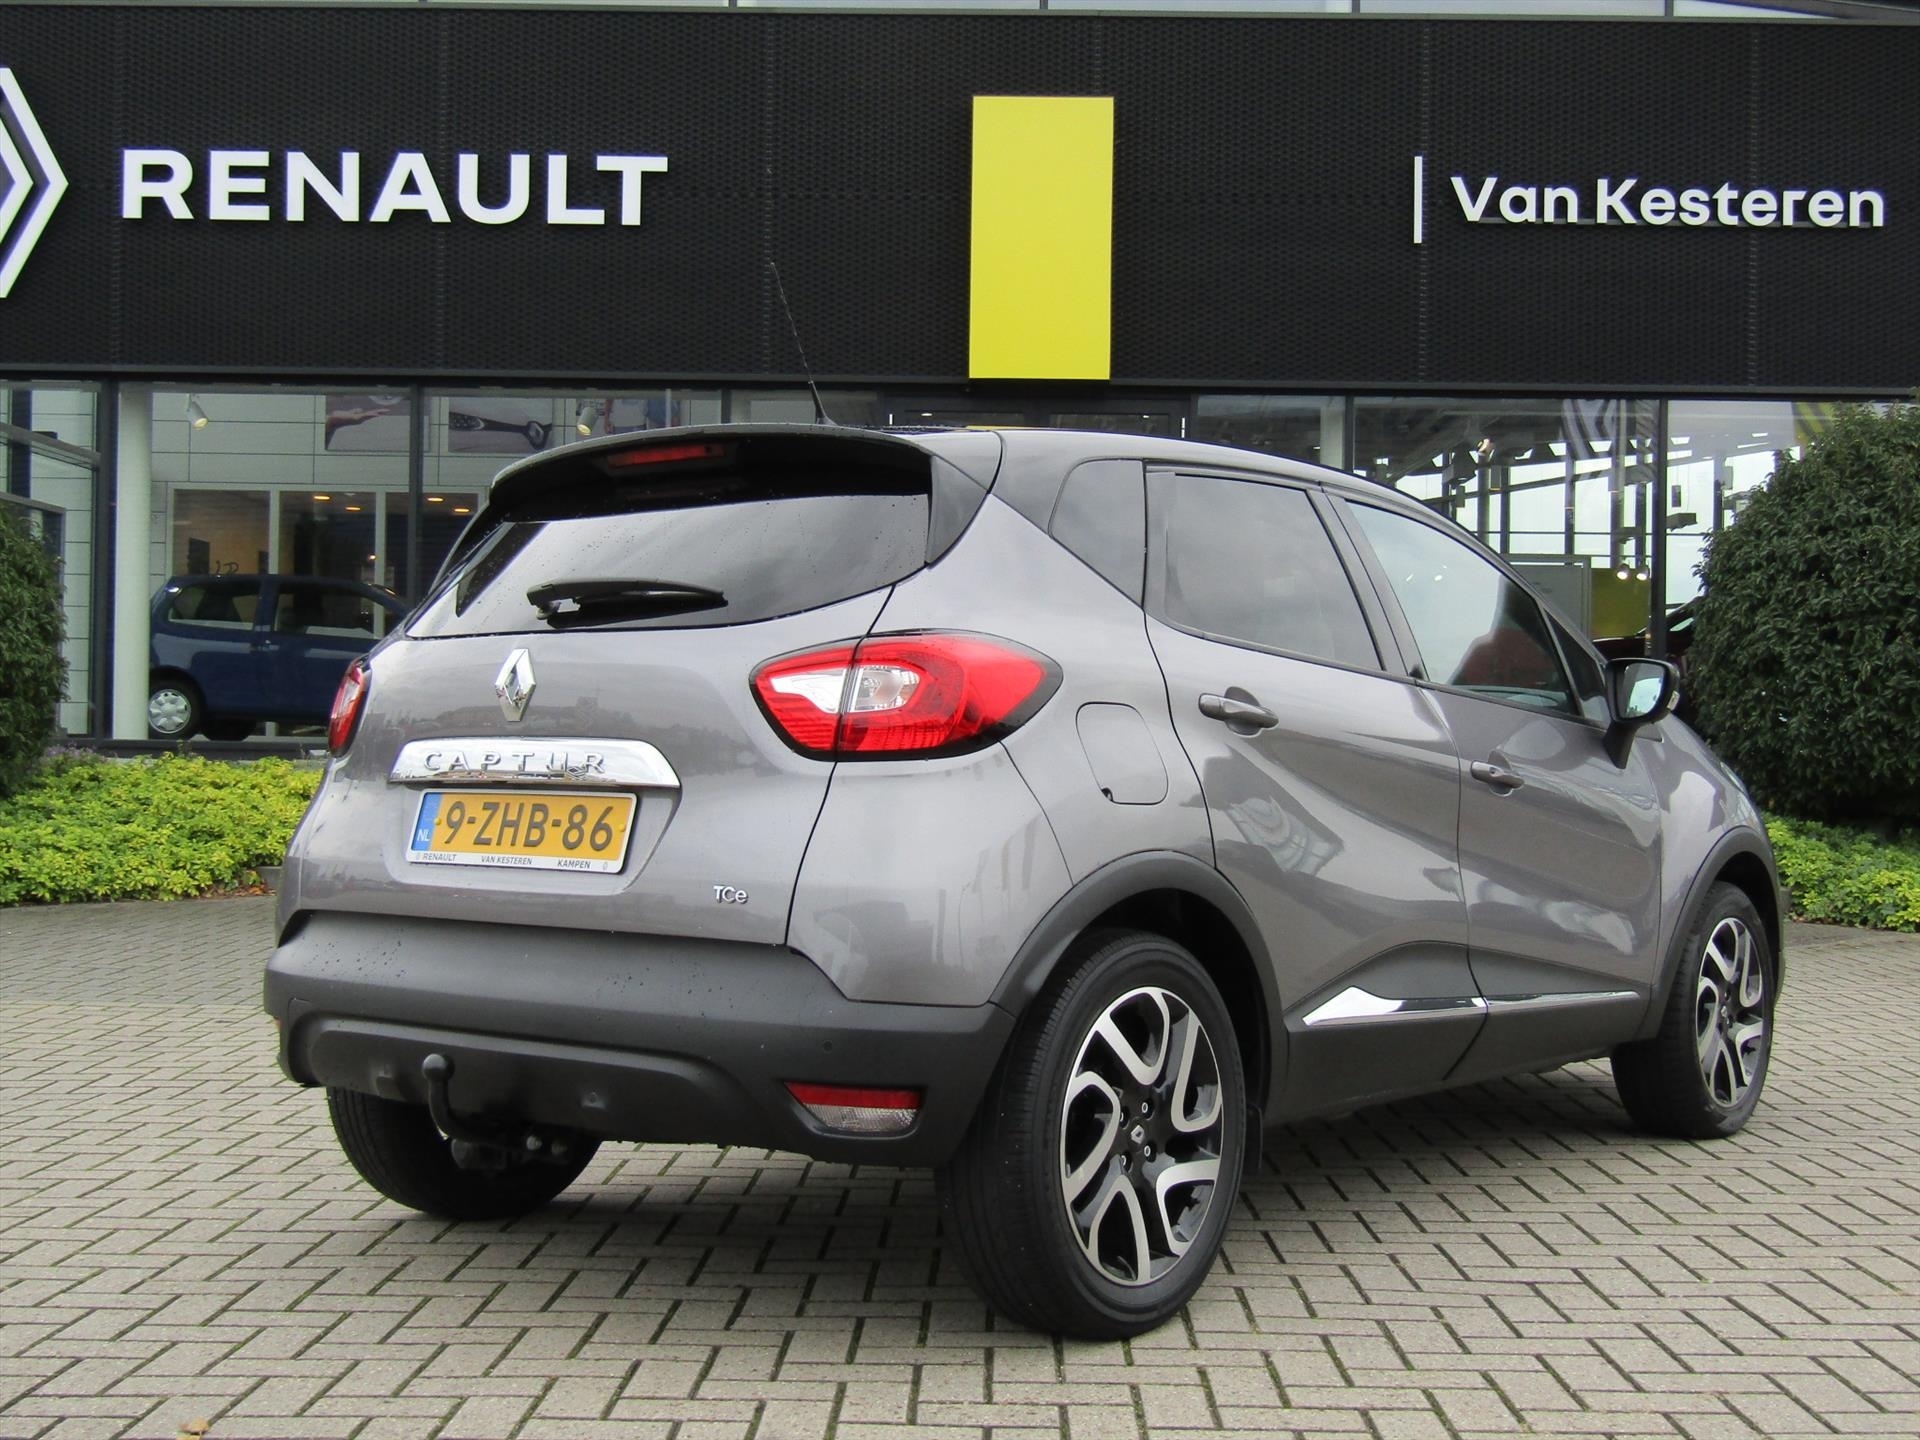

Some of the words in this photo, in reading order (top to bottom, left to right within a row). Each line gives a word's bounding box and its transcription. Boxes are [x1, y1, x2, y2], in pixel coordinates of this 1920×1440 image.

[121, 149, 669, 227] RENAULT
[1450, 176, 1578, 223] Van
[1596, 178, 1884, 227] Kesteren
[424, 751, 606, 774] CAPTUR
[417, 828, 430, 842] NL
[444, 801, 614, 852] 9-ZHB-86
[422, 853, 457, 862] RENAULT
[481, 855, 496, 864] VAN
[496, 857, 532, 866] KESTEREN
[557, 860, 591, 869] KAMPEN
[713, 885, 748, 903] TCe
